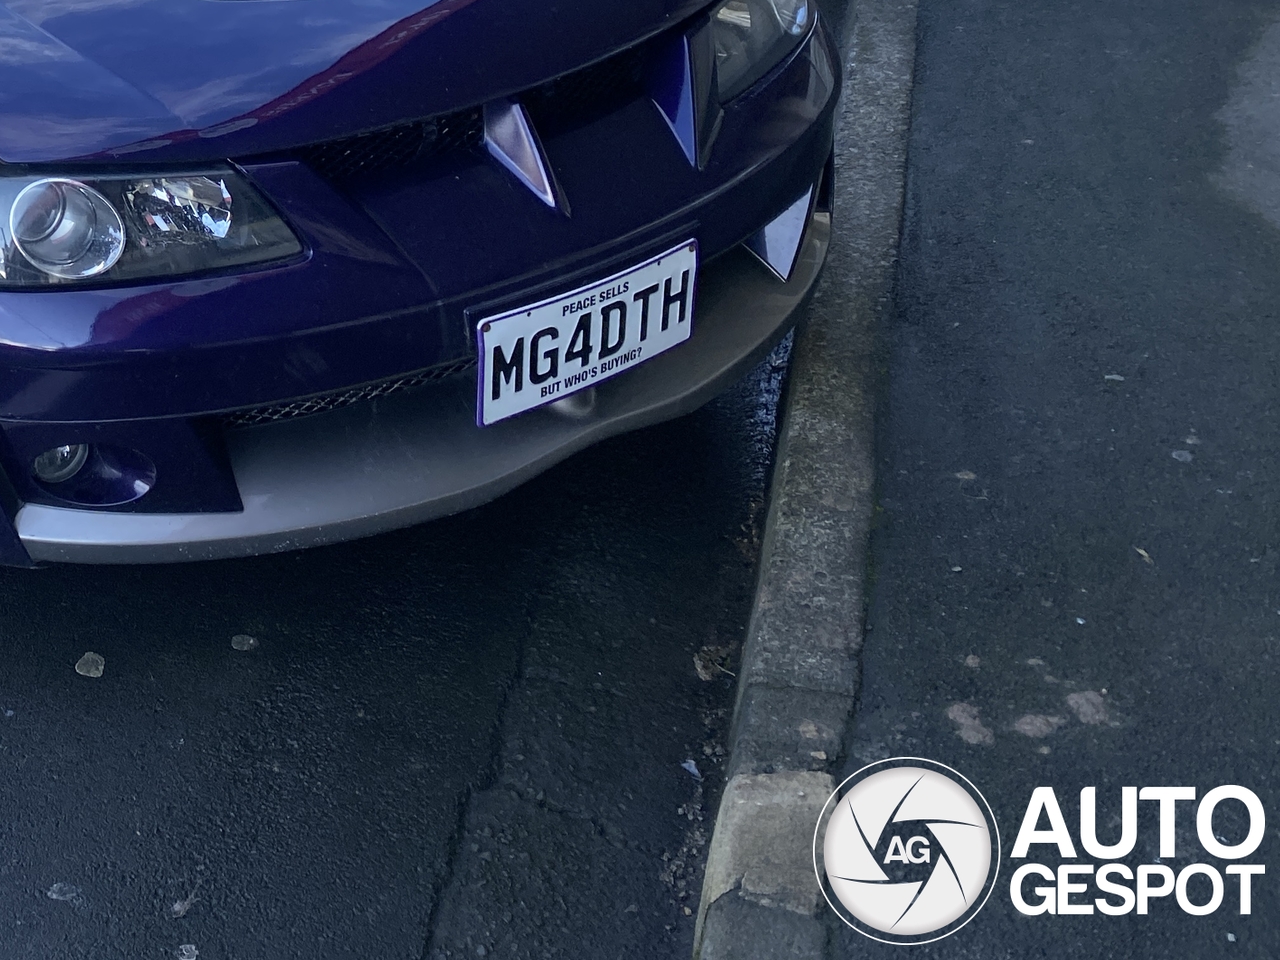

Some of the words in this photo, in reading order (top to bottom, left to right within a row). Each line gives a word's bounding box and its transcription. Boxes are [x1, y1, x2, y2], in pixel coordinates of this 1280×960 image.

[562, 295, 596, 317] PEACE
[599, 281, 629, 302] SELLS
[492, 270, 689, 401] MG4DTH
[540, 381, 561, 398] BUT
[564, 367, 597, 390] WHO'S
[600, 347, 642, 374] BUYING?
